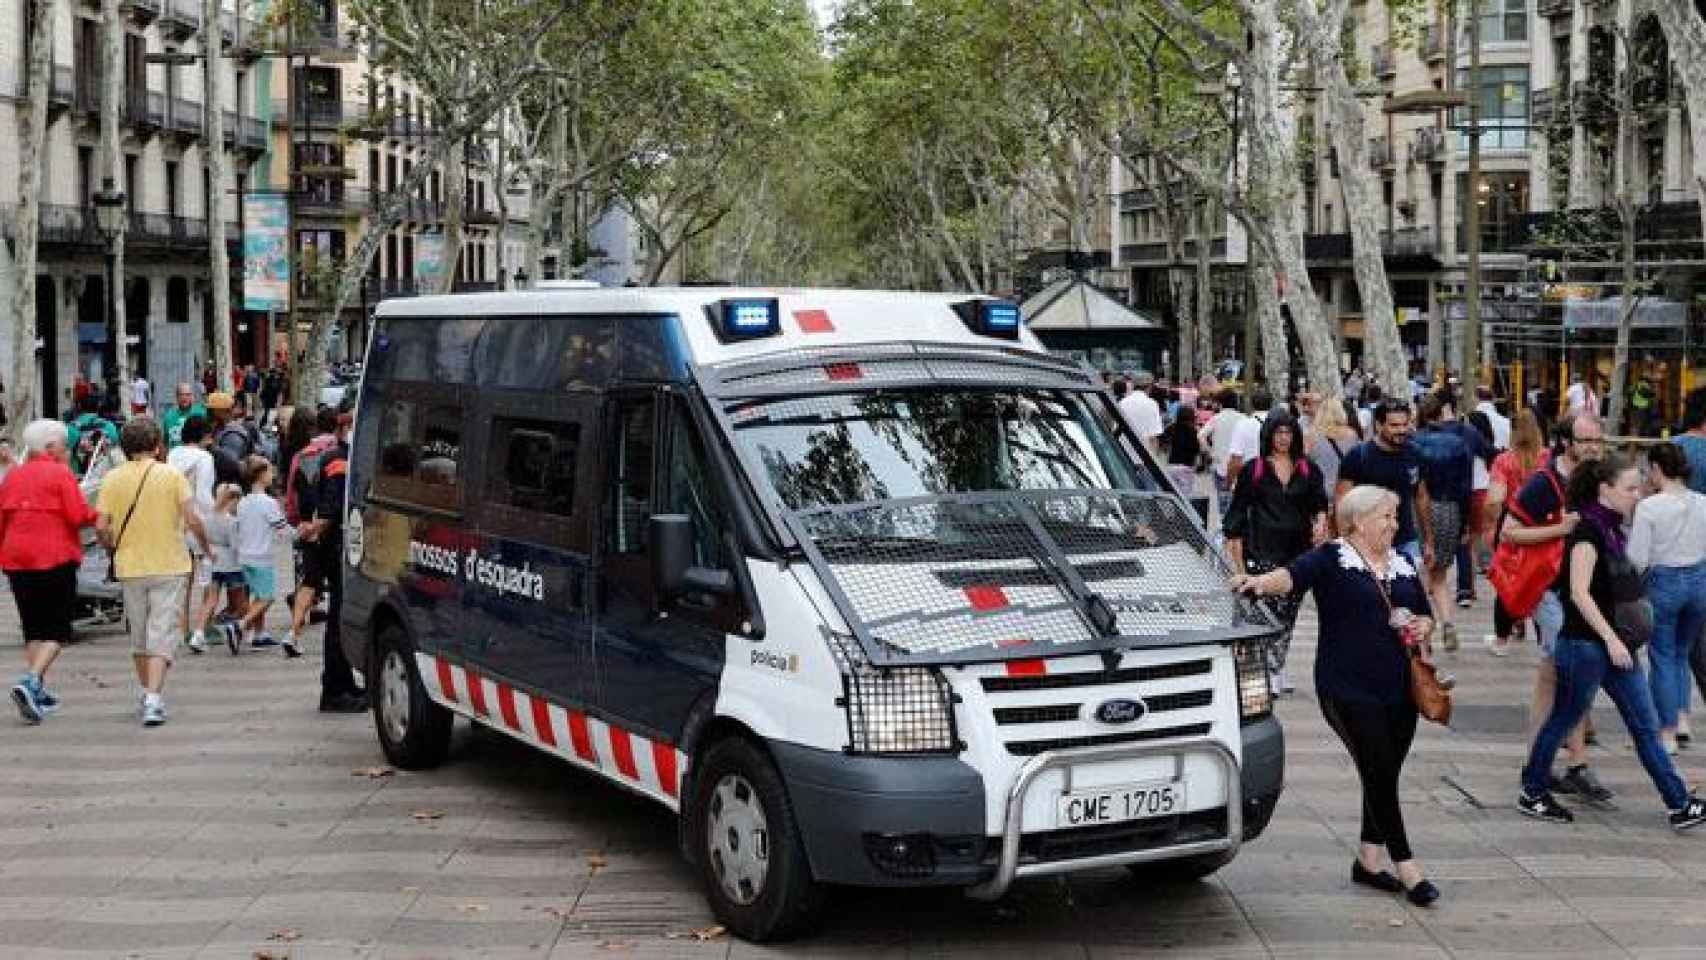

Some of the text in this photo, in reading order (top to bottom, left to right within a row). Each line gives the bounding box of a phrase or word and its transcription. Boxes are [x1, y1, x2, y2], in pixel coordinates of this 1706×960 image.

[409, 540, 543, 601] mossos d'esquadra
[1102, 701, 1136, 720] Ford
[1068, 788, 1174, 825] CME 1705
